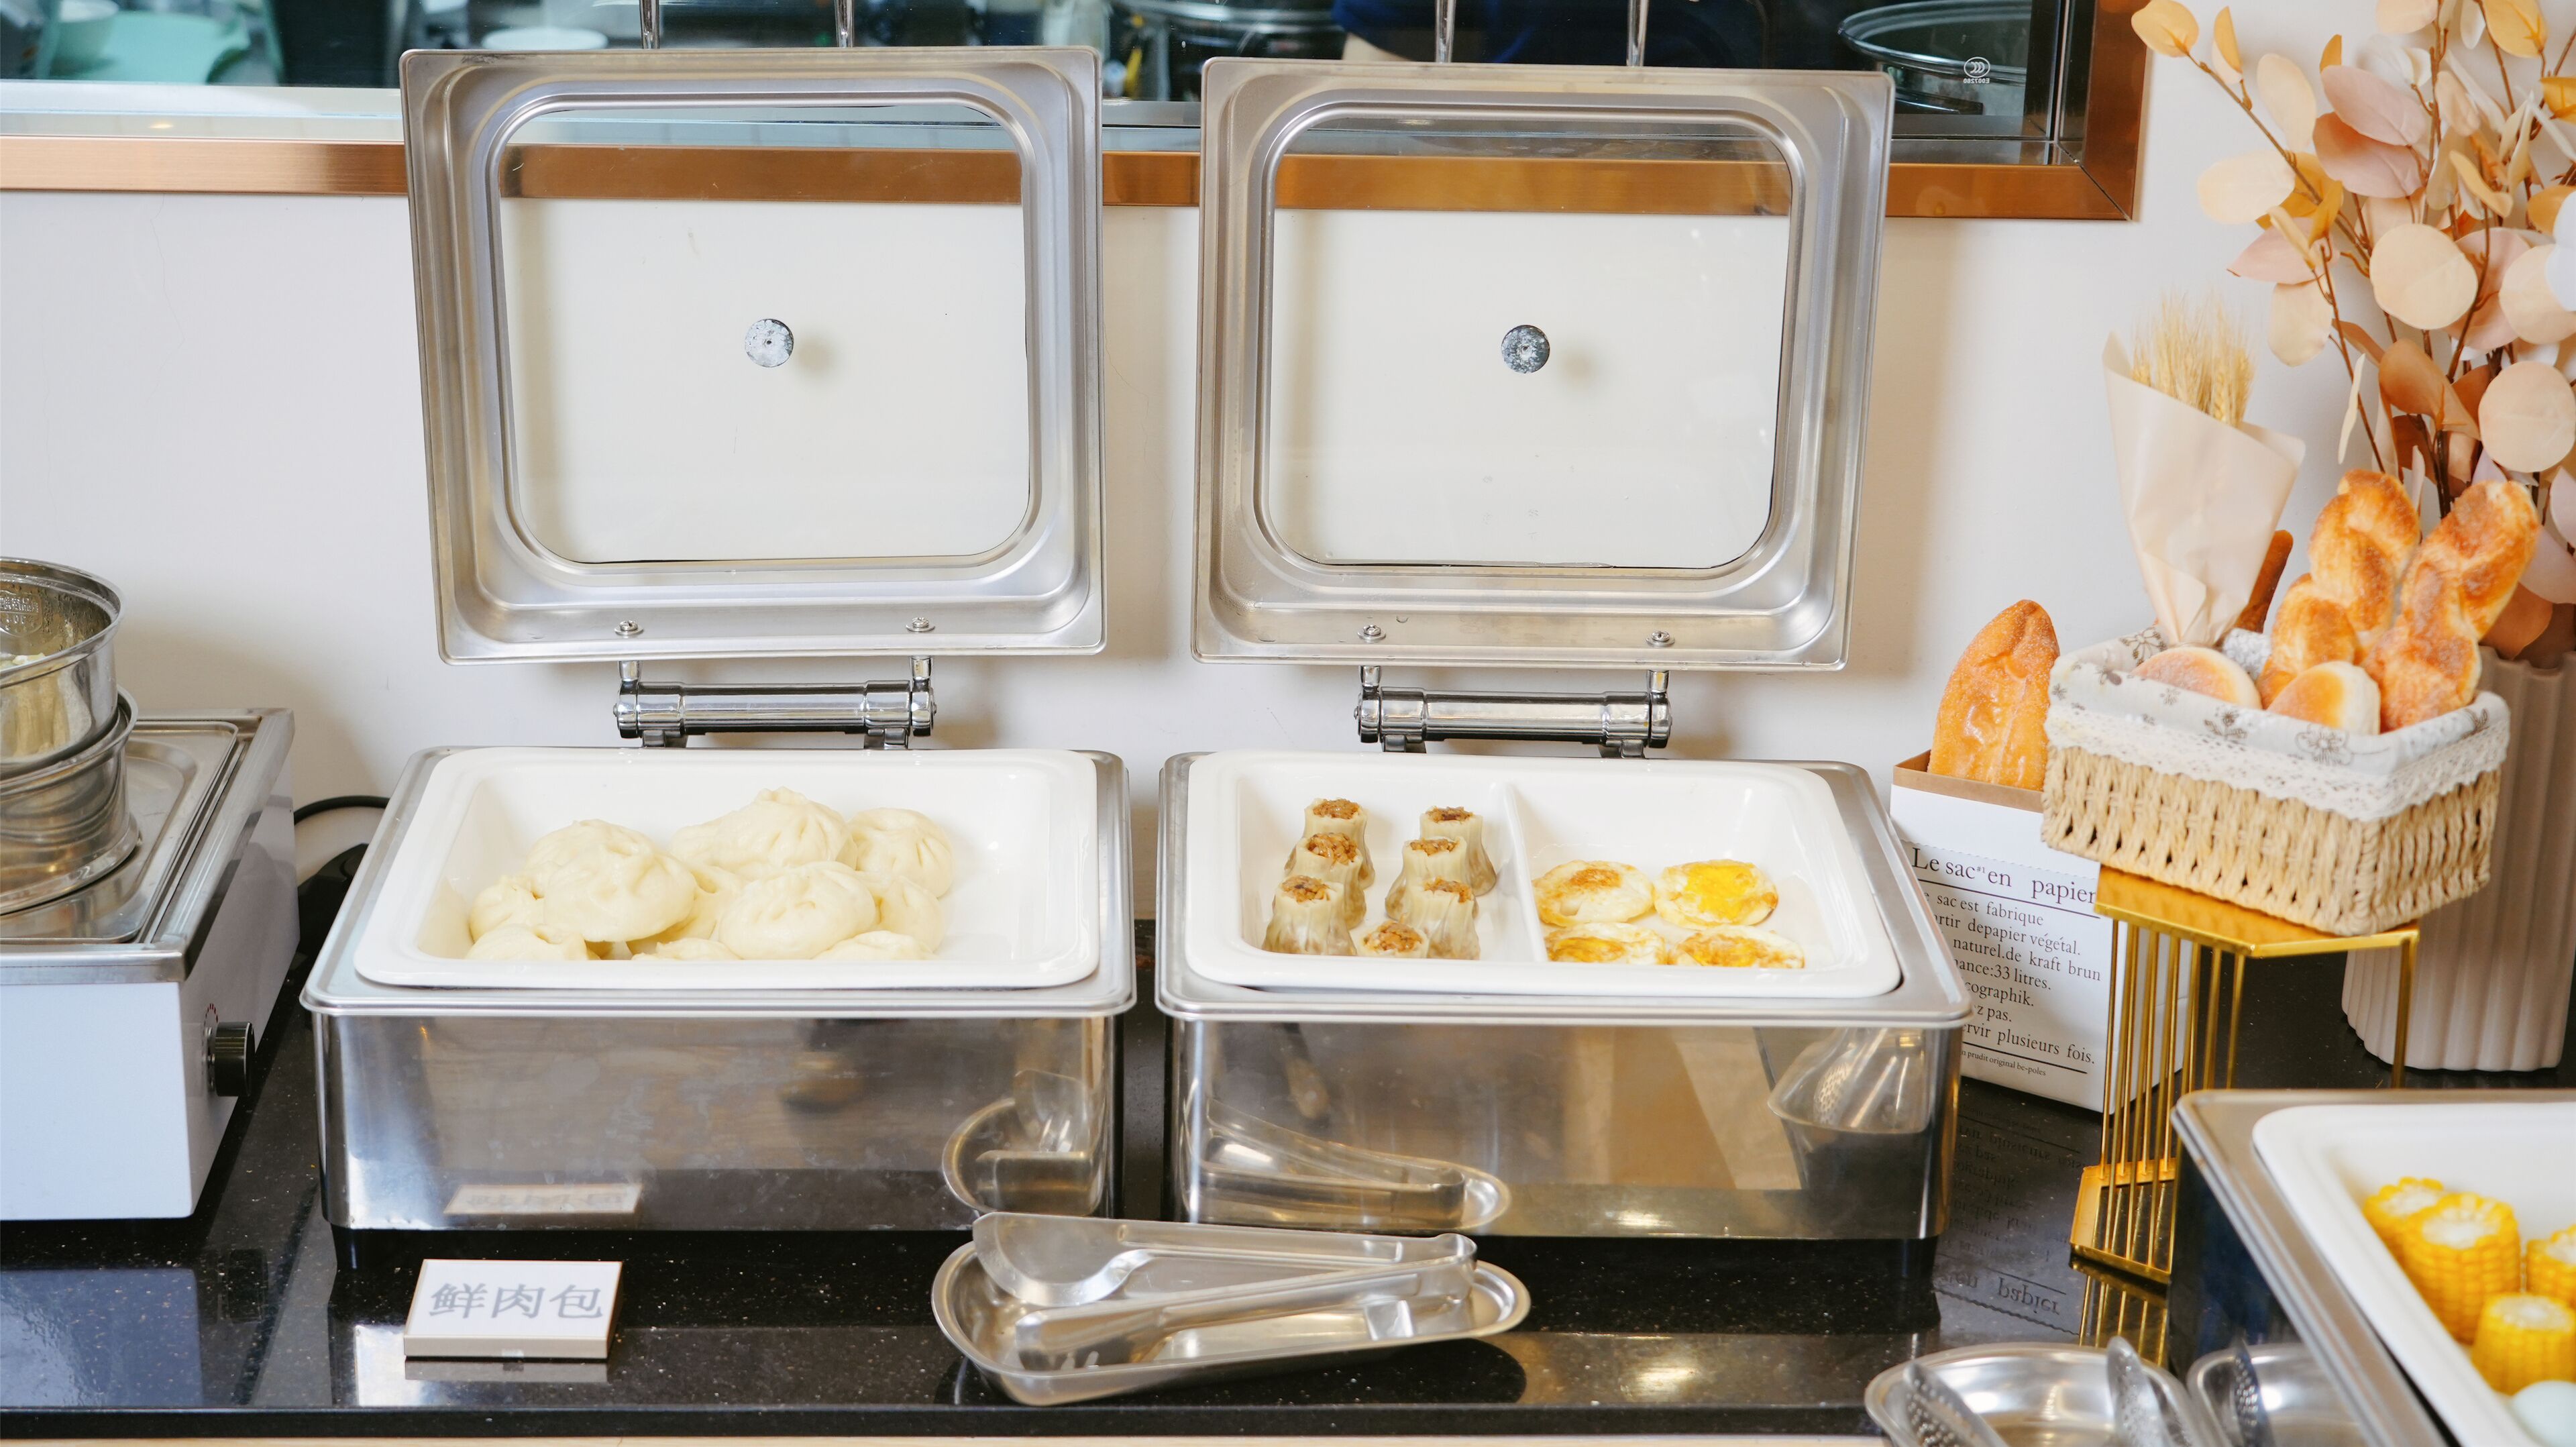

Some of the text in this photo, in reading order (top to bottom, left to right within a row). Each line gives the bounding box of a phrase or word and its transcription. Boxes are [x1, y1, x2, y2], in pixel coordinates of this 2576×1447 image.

[1912, 847, 1939, 871] Le
[1988, 870, 2012, 887] en
[2031, 879, 2096, 904] papier
[1937, 895, 1957, 907] sac
[1960, 900, 1979, 912] est
[1986, 901, 2043, 926] fabrique
[2014, 968, 2051, 990] litres.
[2029, 951, 2061, 971] kraft
[2068, 960, 2100, 981] brun
[1987, 1008, 2012, 1022] pas.
[1997, 1029, 2059, 1055] plusieurs
[2067, 1044, 2094, 1064] fois.
[1989, 1057, 2015, 1068] original
[429, 1283, 603, 1320] 鲜肉包
